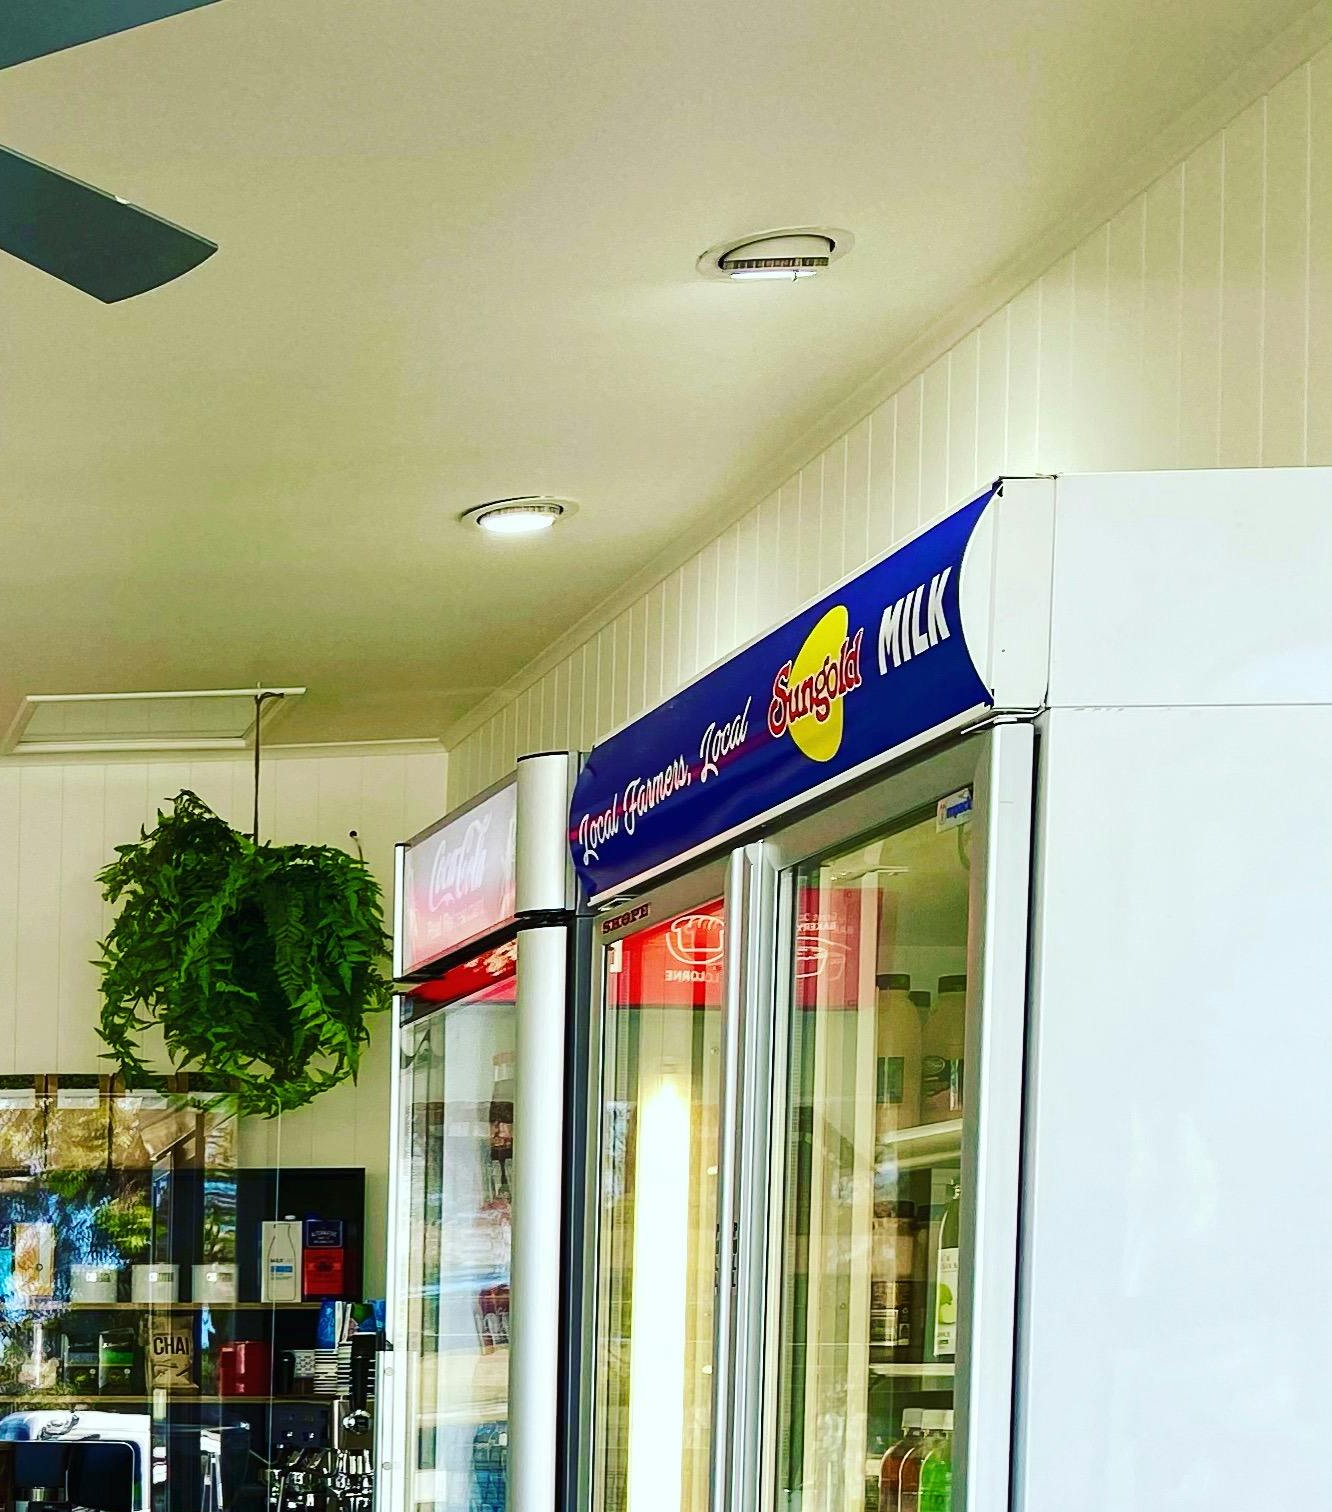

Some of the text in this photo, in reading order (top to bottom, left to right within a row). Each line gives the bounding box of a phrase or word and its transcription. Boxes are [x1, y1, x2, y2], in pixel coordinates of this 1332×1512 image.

[578, 566, 952, 866] Local Farmers, Local Sungold MILK
[153, 1336, 189, 1355] CHAI
